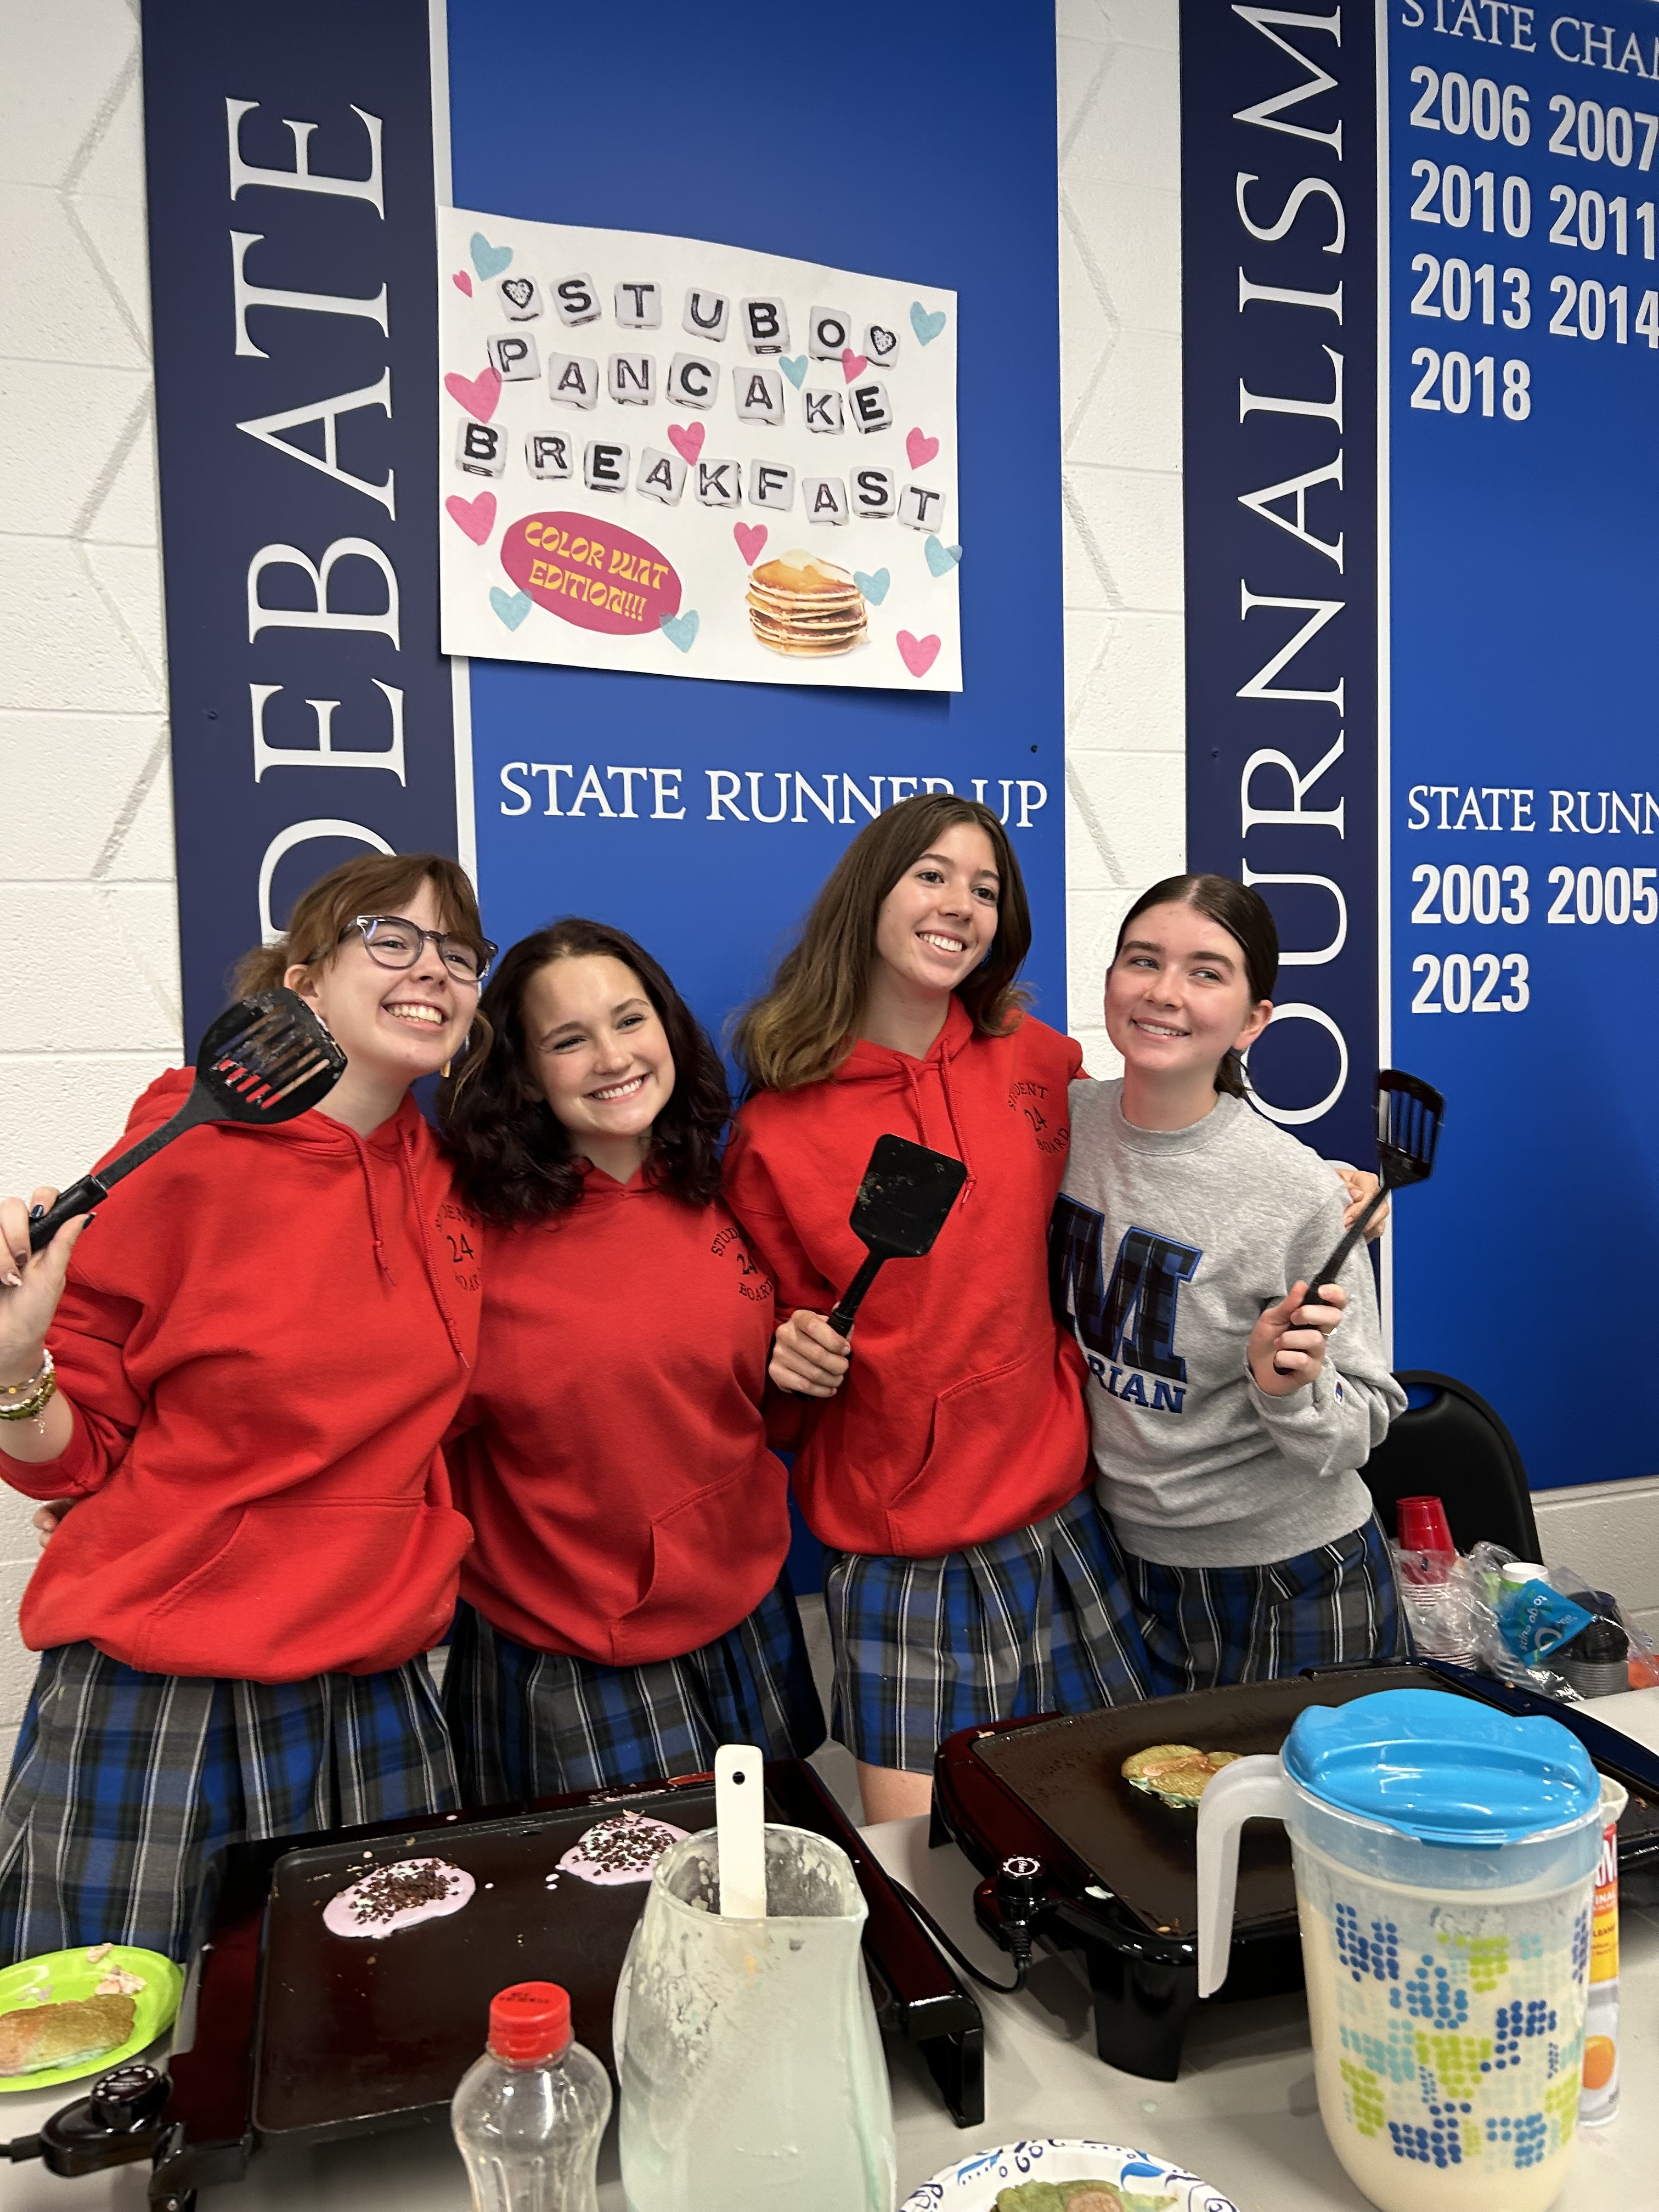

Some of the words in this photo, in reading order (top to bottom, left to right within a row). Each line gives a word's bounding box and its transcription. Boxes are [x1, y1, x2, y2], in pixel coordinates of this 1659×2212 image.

[1402, 0, 1537, 53] STATE
[1550, 15, 1659, 80] CHA
[1410, 65, 1531, 147] 2006
[1548, 94, 1658, 171] 2007
[1410, 159, 1531, 238] 2010
[1549, 184, 1656, 261] 2011
[557, 279, 845, 348] STUBO
[1410, 253, 1531, 329] 2013
[1549, 275, 1659, 349] 2014
[496, 338, 883, 426] PANCAKE
[1410, 347, 1531, 421] 2018
[463, 422, 940, 521] BREAKFAST
[525, 521, 606, 569] COLOR
[528, 558, 647, 622] EDITION!!!
[1231, 4, 1358, 1171] OURNALISM
[500, 761, 686, 820] STATE
[1408, 785, 1536, 832] STATE
[1411, 864, 1530, 924] 2003
[1547, 866, 1658, 925] 2005
[1411, 953, 1530, 1013] 2023
[1024, 1106, 1048, 1132] 24
[447, 1233, 473, 1262] 24
